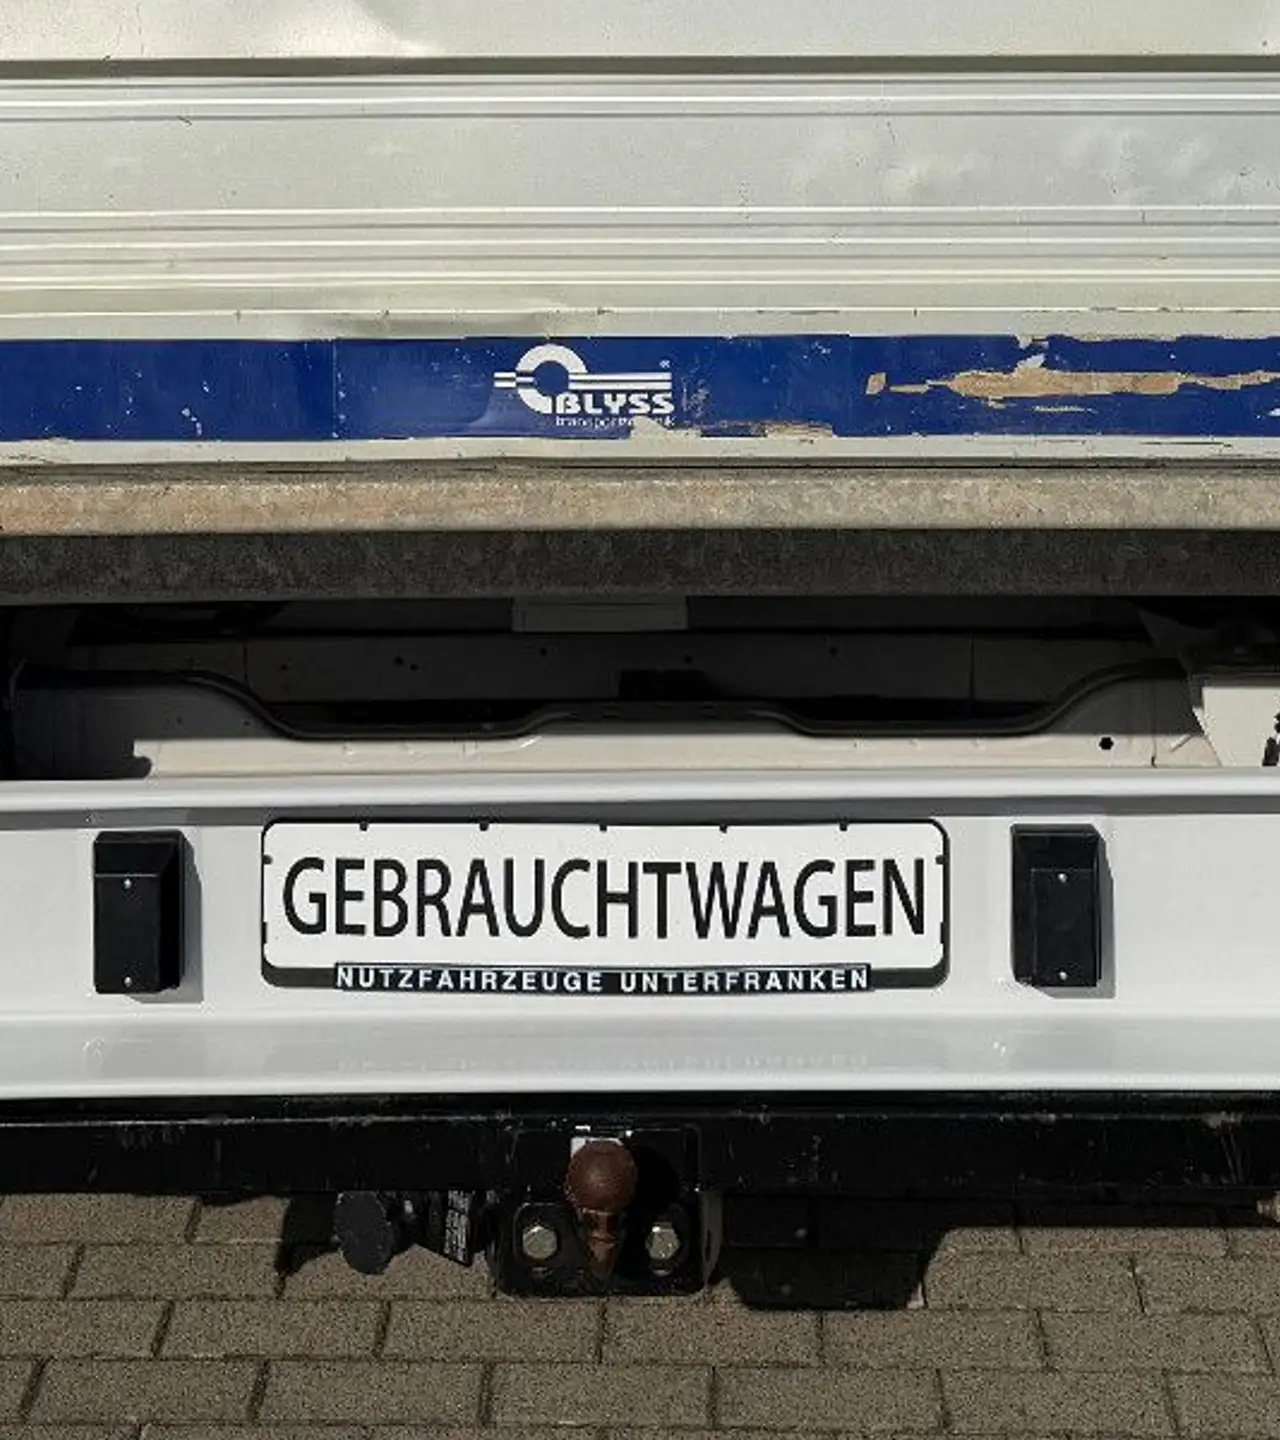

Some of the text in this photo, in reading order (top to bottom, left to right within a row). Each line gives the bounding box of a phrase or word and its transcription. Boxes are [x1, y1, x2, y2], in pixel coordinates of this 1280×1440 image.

[556, 392, 675, 414] BLYSS
[283, 857, 926, 939] GEBRAUCHTWAGEN
[336, 966, 869, 993] NUTZFAHRZEUGE UNTERFRANKEN
